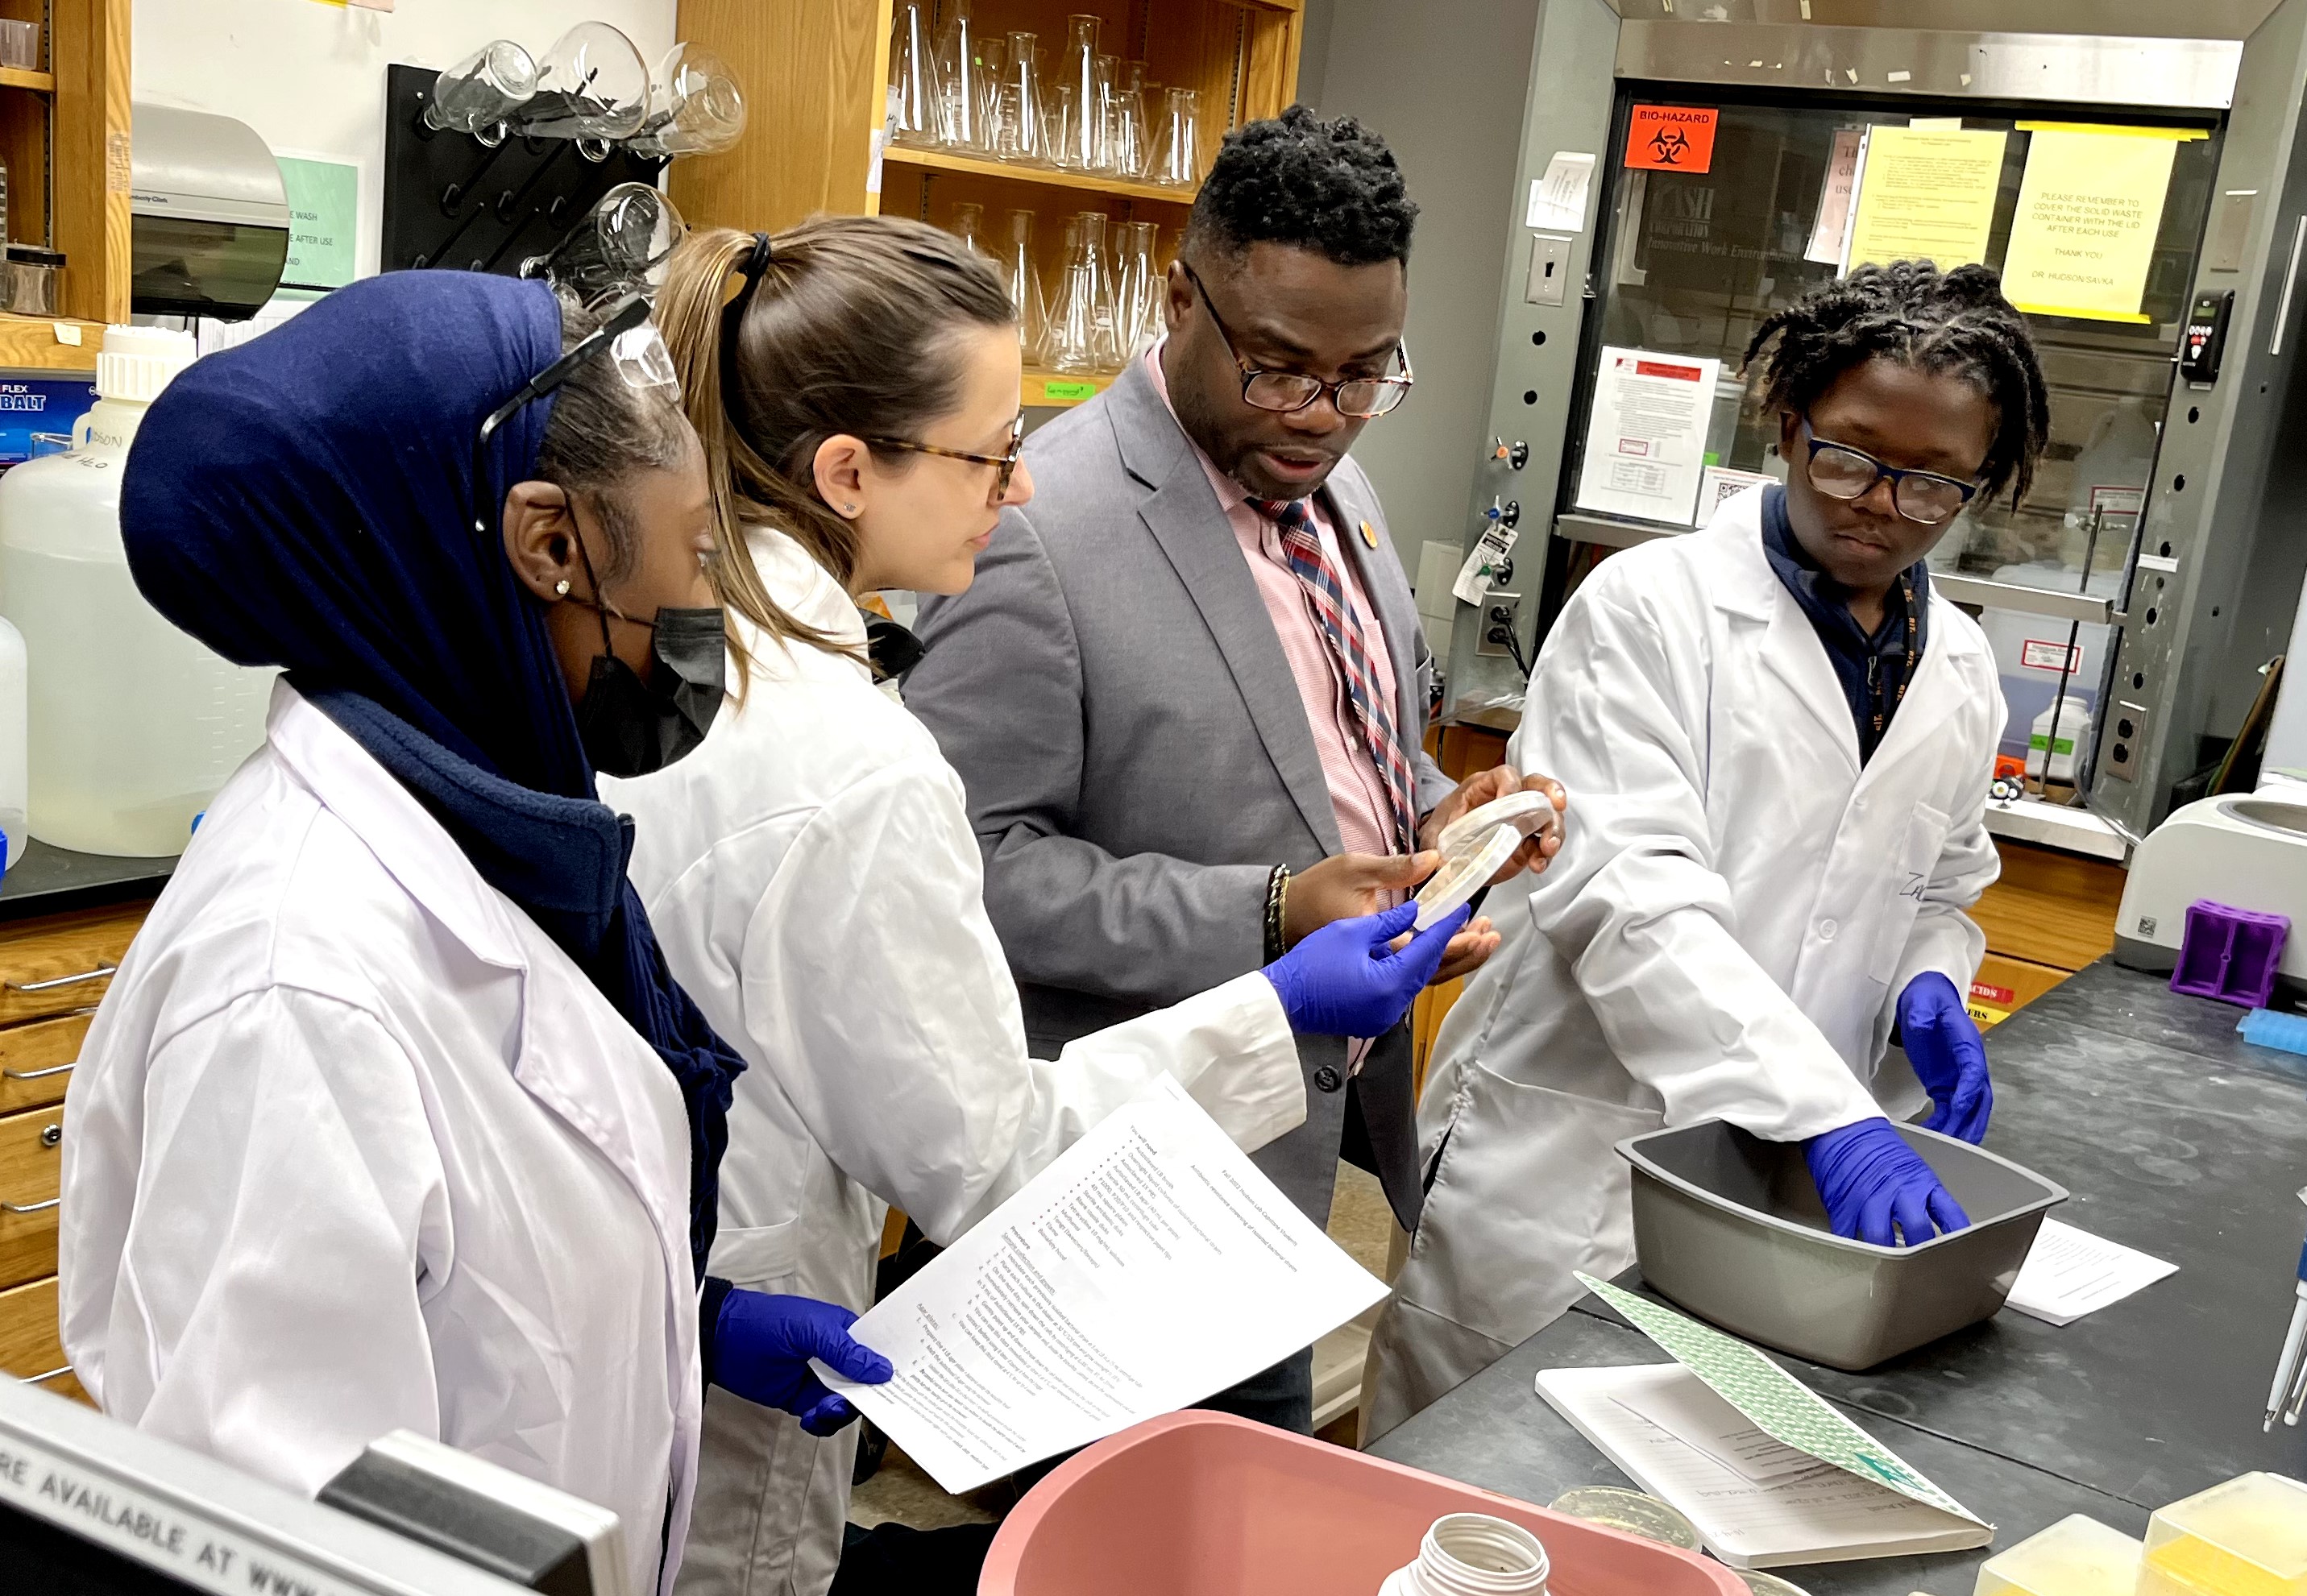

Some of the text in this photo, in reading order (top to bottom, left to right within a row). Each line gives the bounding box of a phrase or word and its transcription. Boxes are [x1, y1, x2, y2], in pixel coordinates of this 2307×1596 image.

[1640, 110, 1709, 124] BIO-HAZARD
[2041, 192, 2139, 208] PLEASE REMEMBER TO
[295, 211, 317, 221] WASH
[2034, 202, 2143, 219] COVER THE SOLID WASTE
[2032, 213, 2140, 230] CONTAINER WITH THE LID
[296, 234, 317, 244] AFTER
[320, 237, 333, 246] USE
[2046, 225, 2119, 238] AFTER EACH USE
[1702, 242, 1728, 256] Work
[2055, 247, 2102, 259] THANK YOU
[2, 384, 28, 394] FLEX
[1138, 1134, 1147, 1143] will
[1121, 1159, 1143, 1184] Autoclaved
[1135, 1146, 1173, 1189] Autoclaved broth
[1113, 1165, 1136, 1190] Autoclaved
[1128, 1153, 1148, 1175] Overnight
[1147, 1173, 1160, 1188] liquid
[1158, 1187, 1174, 1204] cultures
[1178, 1209, 1194, 1225] isolated
[1076, 1196, 1087, 1210] Blank
[1083, 1190, 1096, 1205] Sterile
[1095, 1205, 1114, 1225] antibiotic
[1102, 1198, 1116, 1213] square
[1190, 1165, 1210, 1186] Antibiotic
[1210, 1186, 1230, 1207] resistance
[1229, 1206, 1248, 1226] screening
[1252, 1229, 1269, 1245] isolated
[1068, 1202, 1091, 1229] Tetracycline
[1127, 1212, 1136, 1221] and
[1038, 1229, 1056, 1250] Biosafety
[1000, 1260, 1011, 1273] Place
[1010, 1273, 1020, 1283] each
[1019, 1283, 1032, 1298] culture
[1008, 1254, 1026, 1275] Inoculate
[1025, 1275, 1035, 1285] each
[1033, 1285, 1052, 1306] previously
[1052, 1305, 1067, 1320] isolated
[993, 1266, 999, 1275] On
[1005, 1283, 1014, 1293] next
[1028, 1310, 1039, 1321] down
[985, 1273, 1042, 1339] Immediately retrieve your samples
[994, 1301, 1014, 1323] autoclaved
[981, 1301, 994, 1316] Gently
[1007, 1331, 1015, 1339] and
[923, 1324, 937, 1342] Prepare
[965, 1329, 973, 1337] can
[993, 1330, 1001, 1338] this
[39, 1474, 188, 1555] AVAILABLE
[197, 1541, 238, 1576] AT
